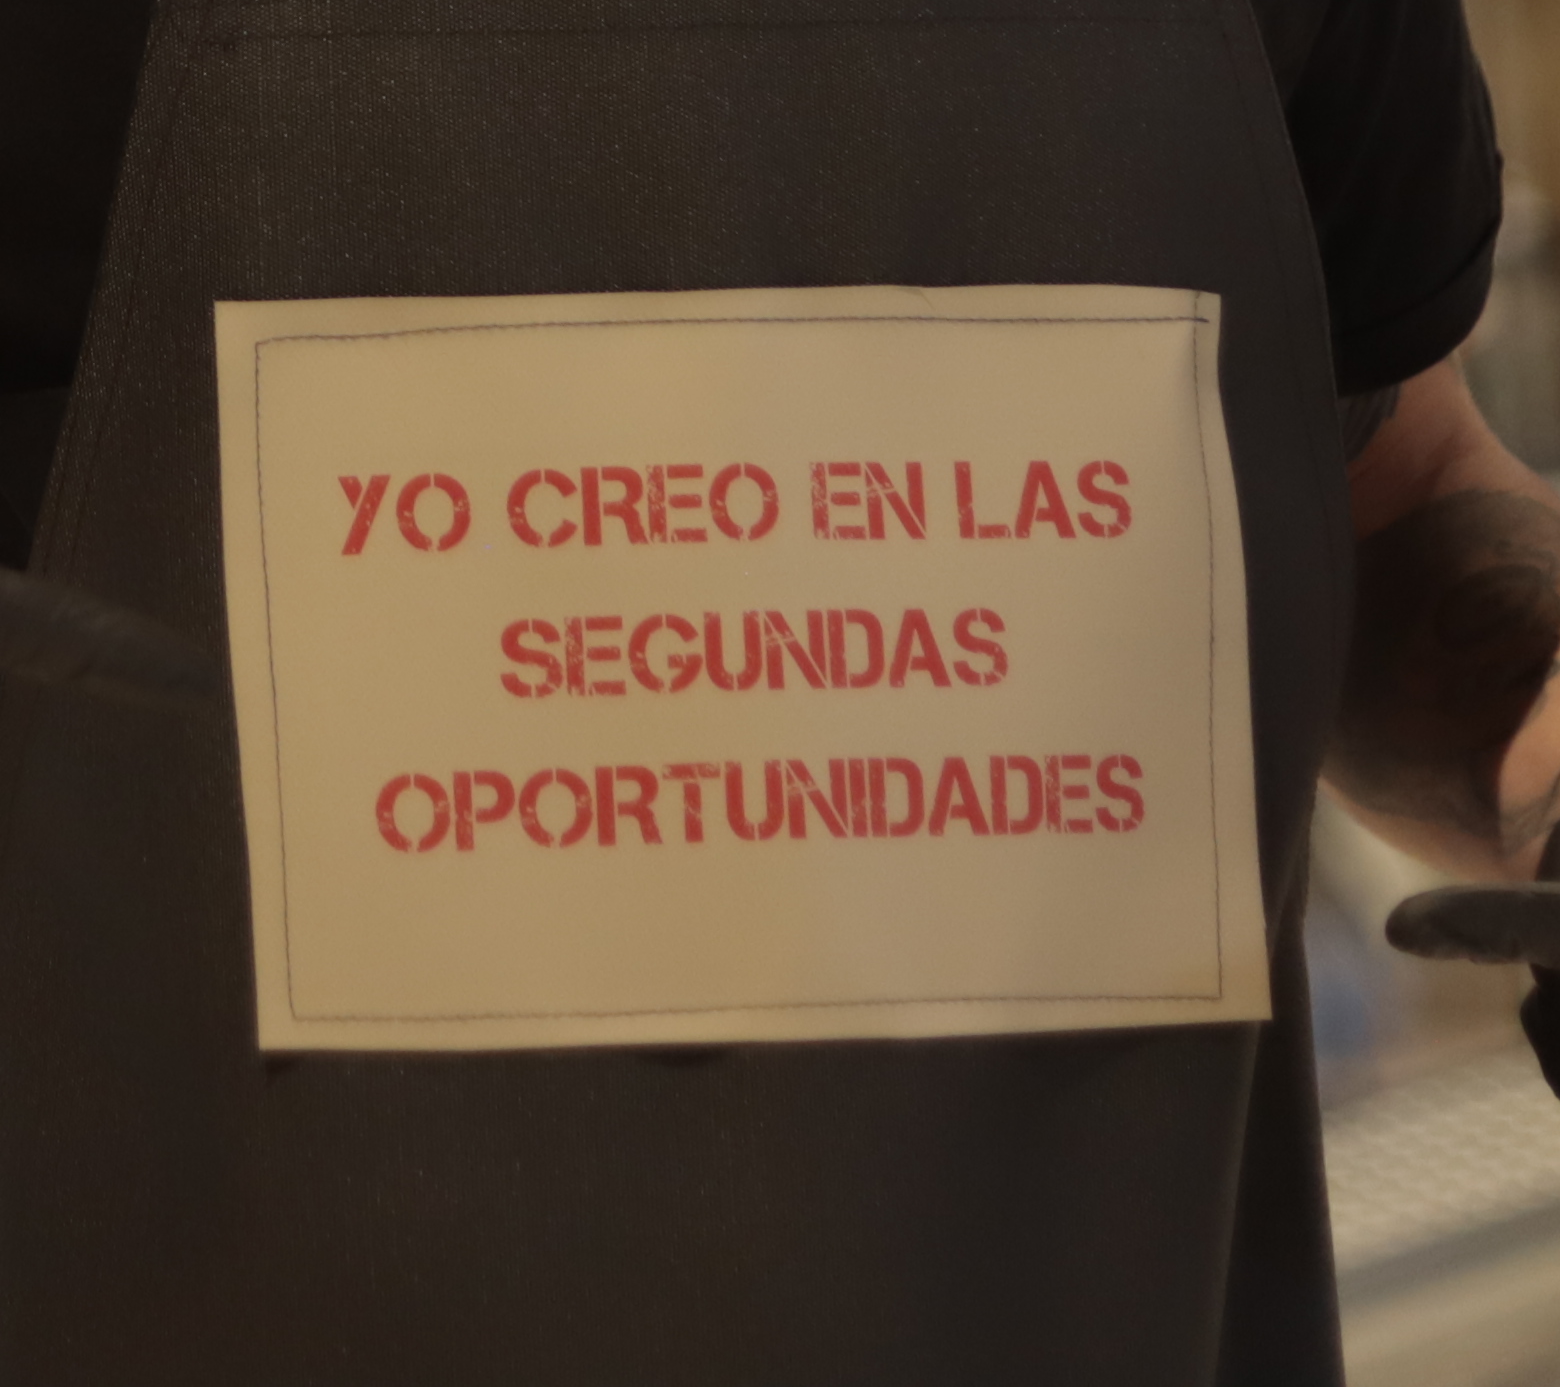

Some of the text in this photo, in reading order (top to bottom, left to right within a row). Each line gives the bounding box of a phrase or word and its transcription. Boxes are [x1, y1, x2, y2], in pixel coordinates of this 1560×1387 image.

[338, 460, 1133, 556] YO CREO EN LAS
[500, 608, 1009, 699] SEGUNDAS
[375, 754, 1145, 853] OPORTUNIDADES
